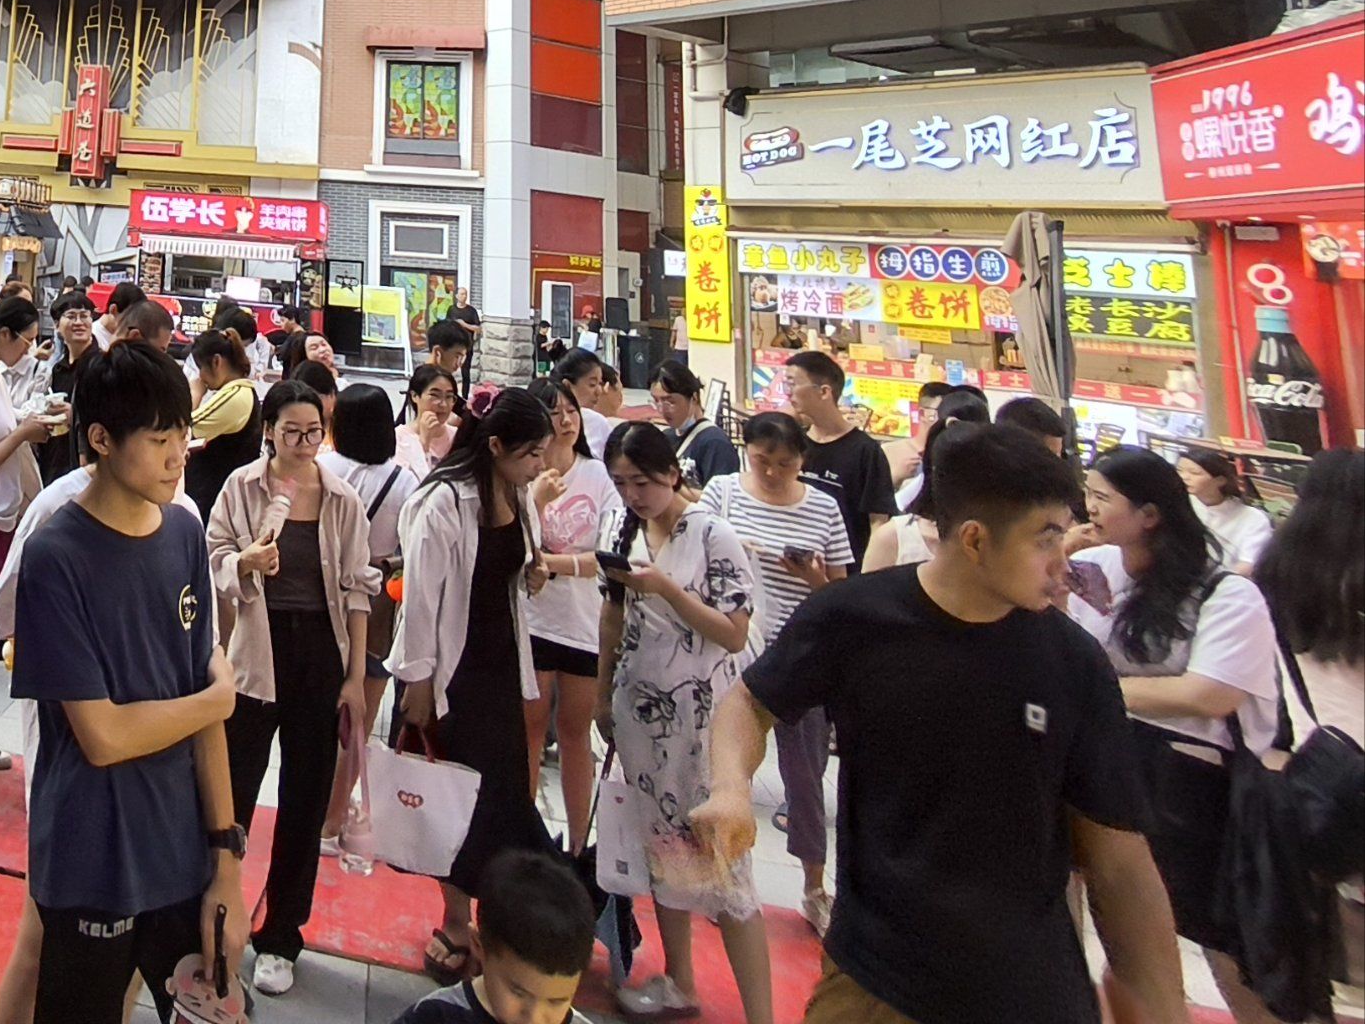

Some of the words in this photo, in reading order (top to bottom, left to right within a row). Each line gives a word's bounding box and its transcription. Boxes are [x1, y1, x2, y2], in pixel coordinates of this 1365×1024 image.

[1201, 80, 1253, 113] 1996
[75, 78, 96, 163] 六道巷
[1305, 72, 1365, 155] 鸡
[808, 106, 1138, 173] 一尾芝网红店
[742, 151, 769, 165] HOT
[770, 146, 797, 160] DOG
[141, 195, 227, 226] 伍学长
[259, 204, 308, 219] 羊肉串
[743, 243, 866, 274] 章鱼小丸子
[880, 251, 1002, 277] 拇指生煎
[694, 261, 721, 334] 卷饼
[781, 289, 845, 315] 烤冷面
[906, 286, 970, 324] 卷饼
[1067, 313, 1192, 342] 臭豆腐
